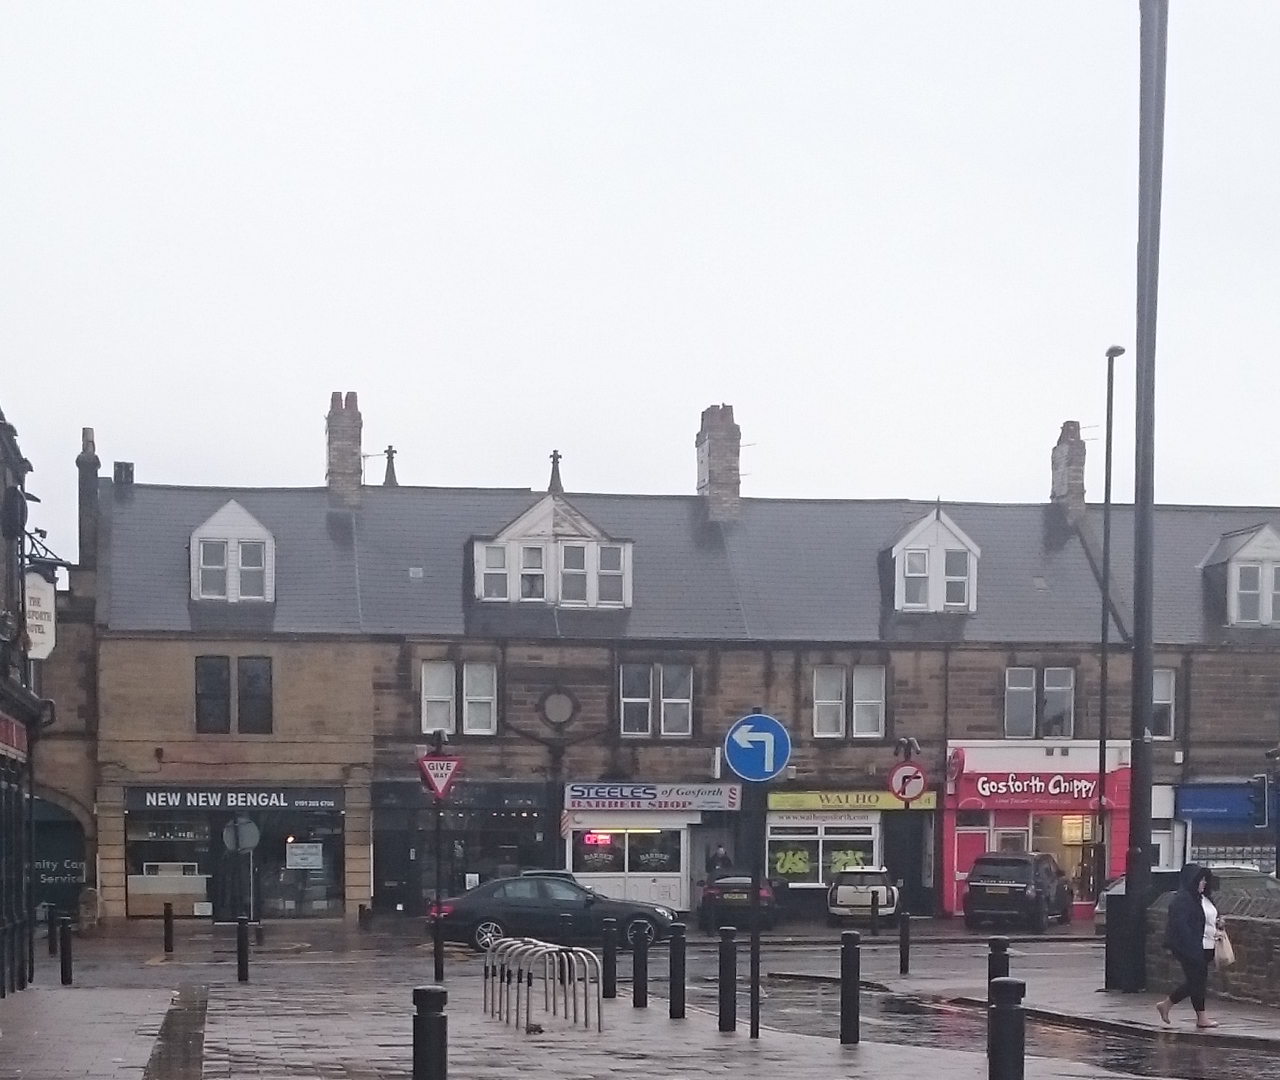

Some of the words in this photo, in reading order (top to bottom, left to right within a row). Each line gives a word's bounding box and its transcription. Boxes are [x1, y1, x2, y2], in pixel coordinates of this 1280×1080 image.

[428, 762, 452, 771] GIVE
[977, 773, 1045, 797] Gosforth
[1048, 774, 1097, 799] Chippy
[571, 785, 658, 800] STEELES
[146, 792, 181, 806] NEW
[187, 793, 221, 806] NEW
[227, 793, 288, 806] BENGAL
[571, 800, 642, 808] BARBER
[648, 800, 693, 808] SHOP
[855, 794, 880, 804] HO
